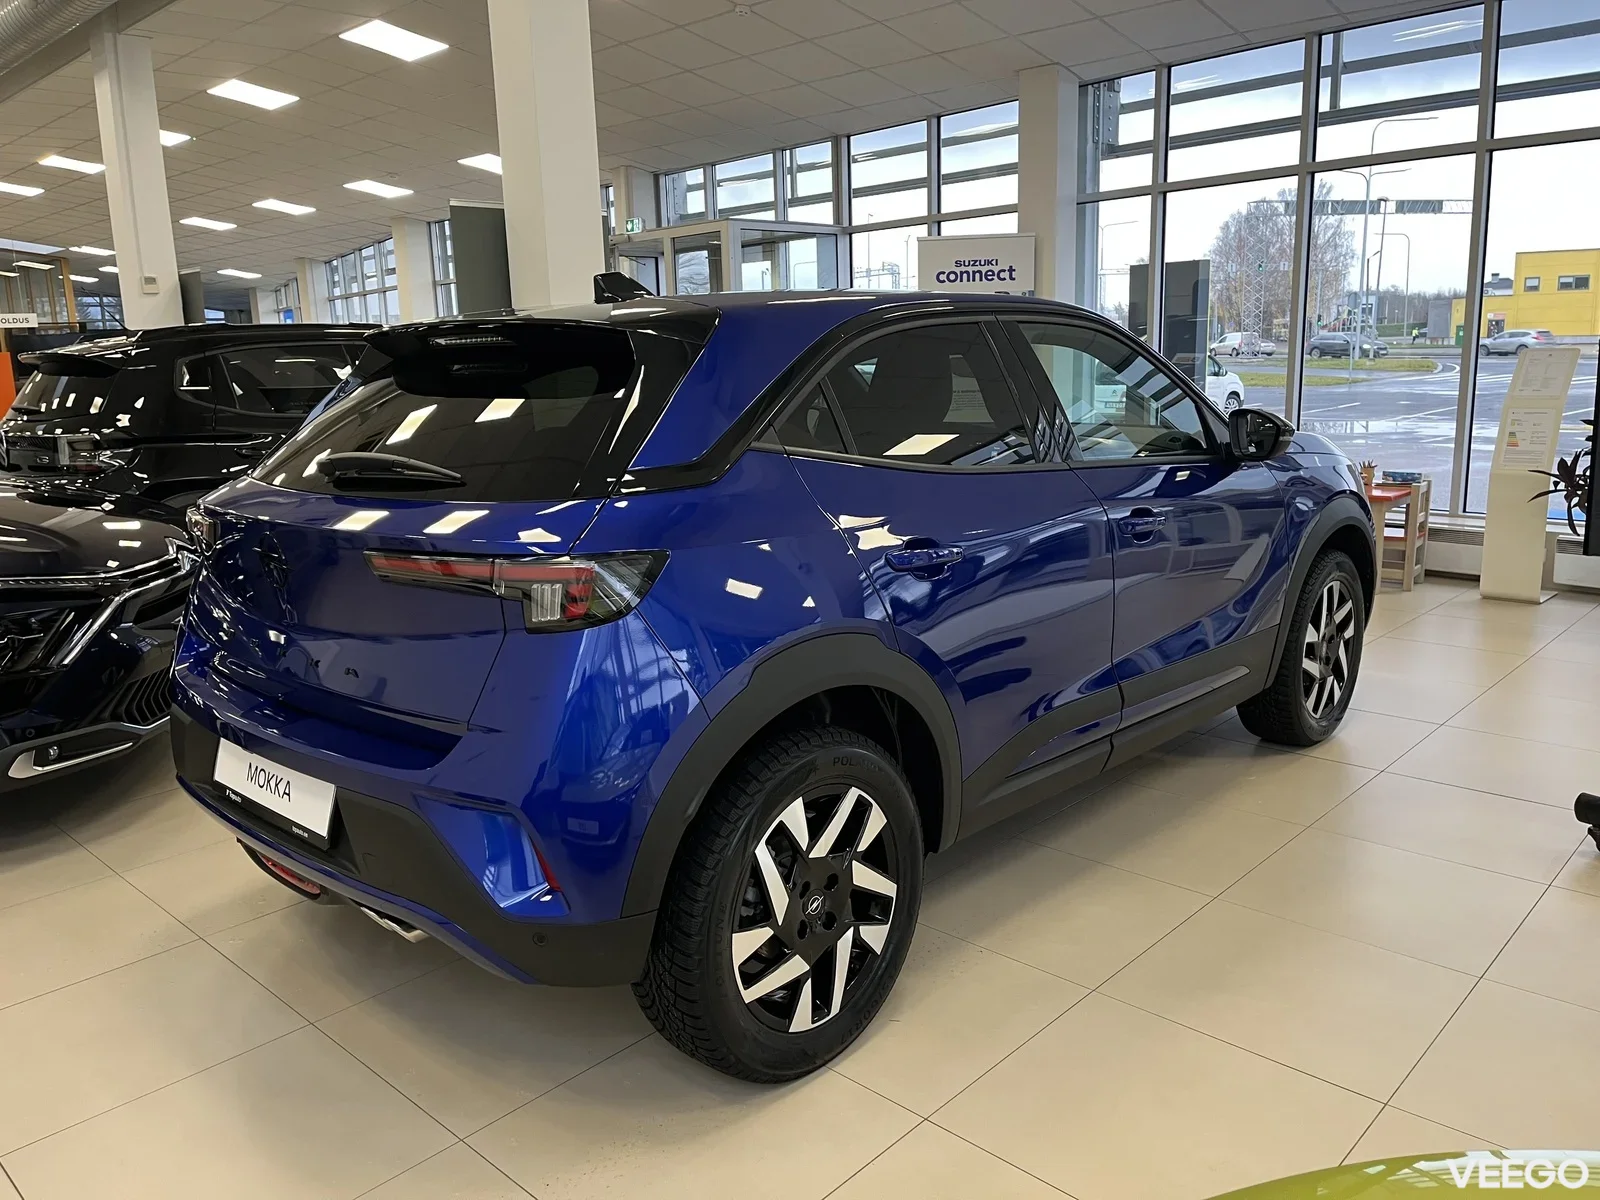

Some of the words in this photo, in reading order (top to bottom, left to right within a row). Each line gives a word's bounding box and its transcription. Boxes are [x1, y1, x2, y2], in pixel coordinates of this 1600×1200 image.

[954, 258, 999, 268] SUZUKI
[935, 265, 1017, 284] connect
[246, 762, 292, 803] MOKKA
